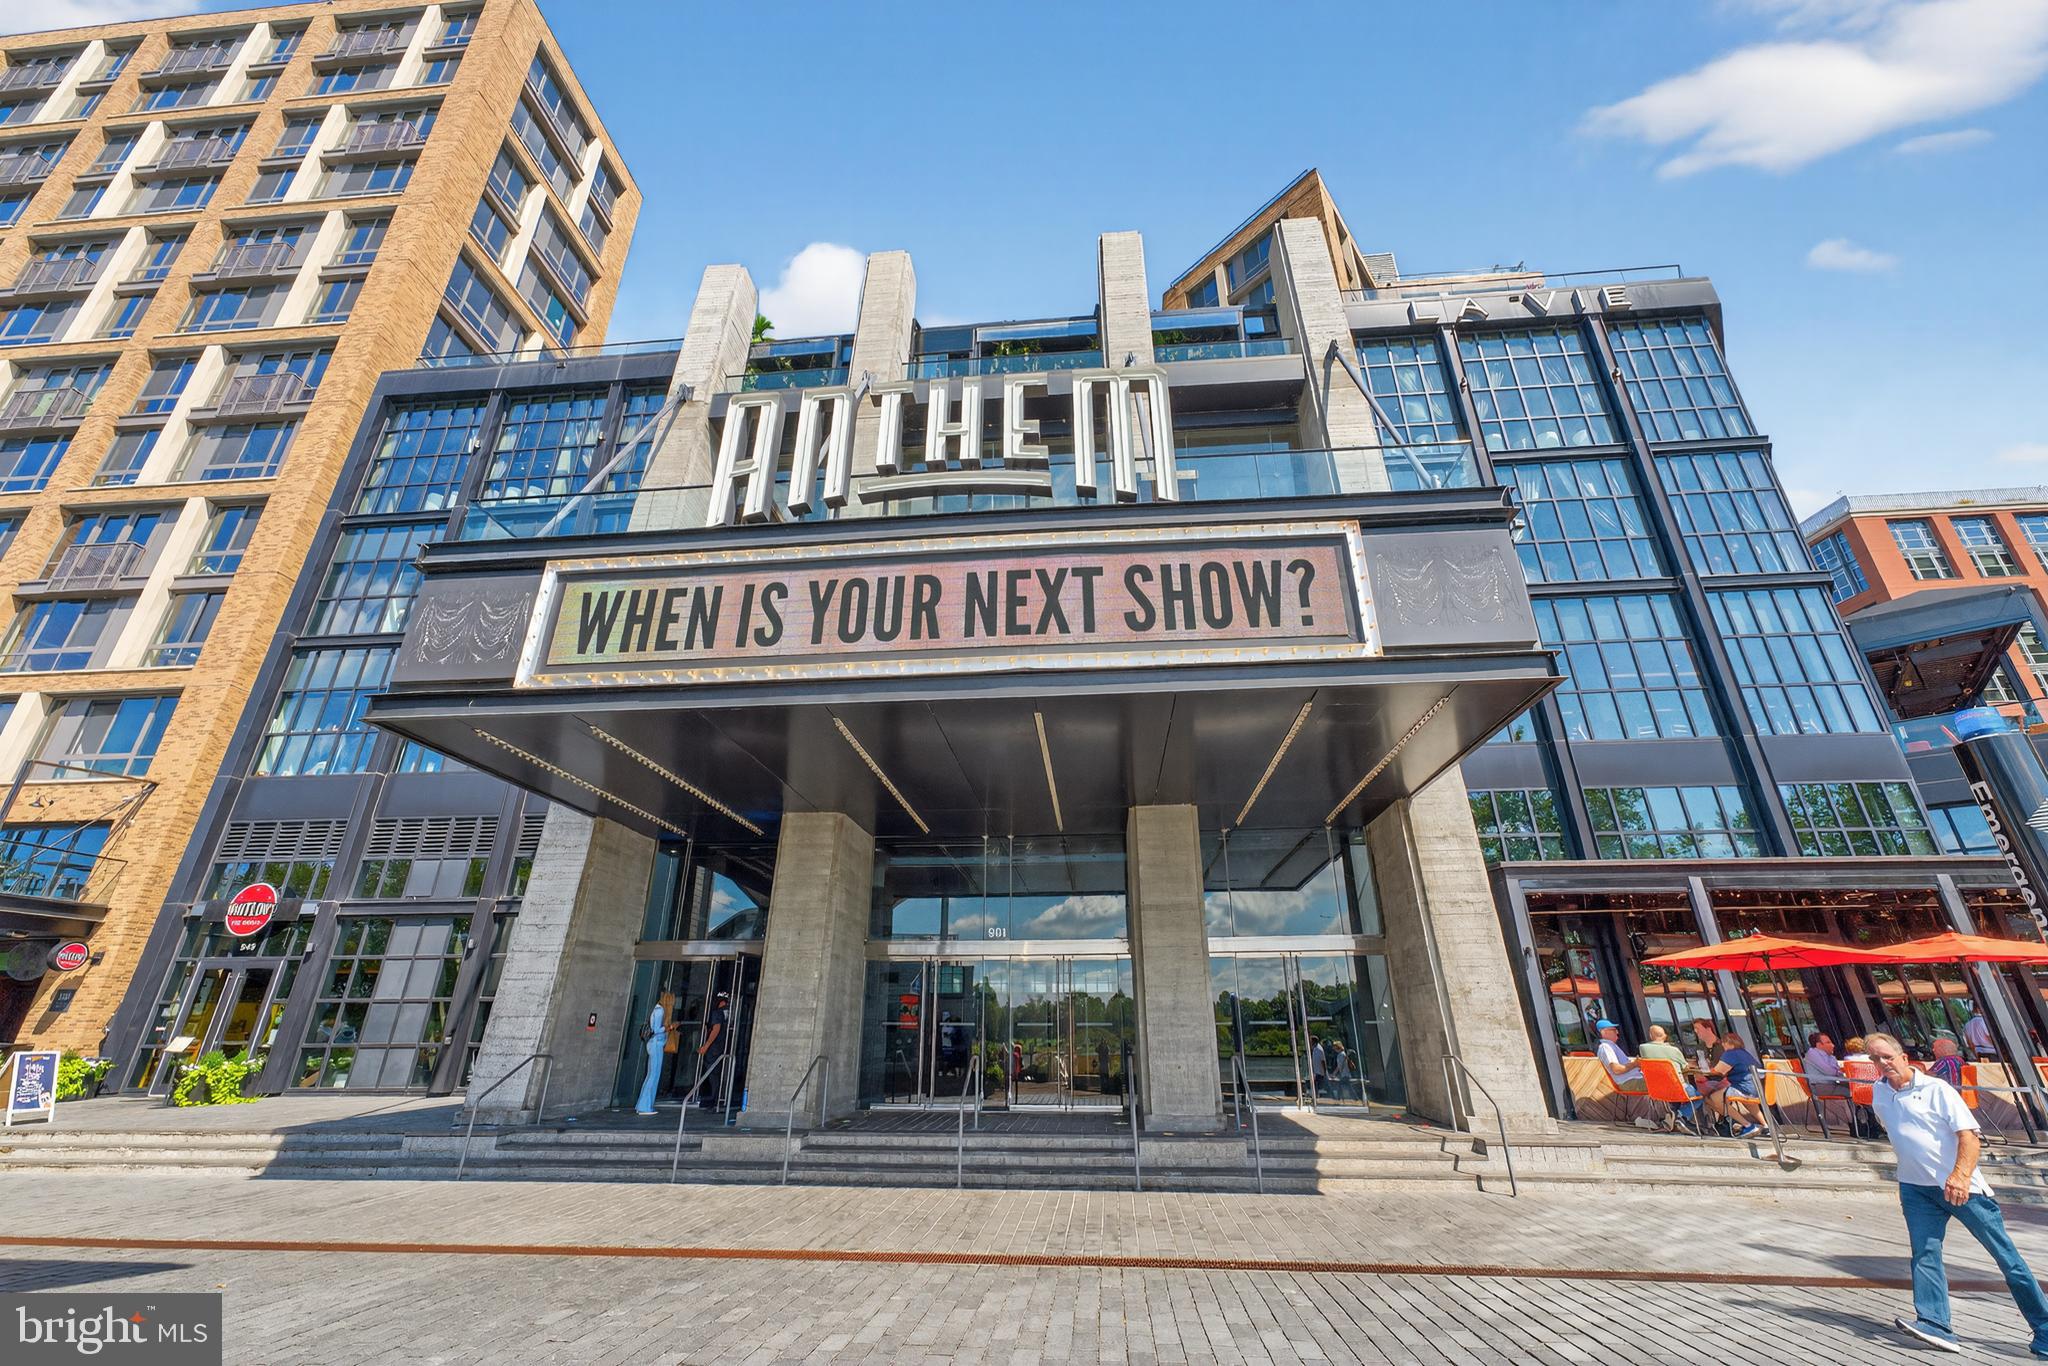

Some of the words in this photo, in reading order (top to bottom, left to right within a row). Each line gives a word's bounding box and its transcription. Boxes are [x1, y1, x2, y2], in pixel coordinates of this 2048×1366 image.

[1408, 297, 1489, 324] LA
[1522, 286, 1632, 316] VIE
[706, 366, 1179, 527] ANTHEM
[577, 585, 724, 655] WHEN
[735, 581, 789, 648] IS
[809, 574, 943, 646] YOUR
[964, 566, 1103, 638] NEXT
[1124, 558, 1316, 632] SHOW?
[988, 927, 1006, 938] 901
